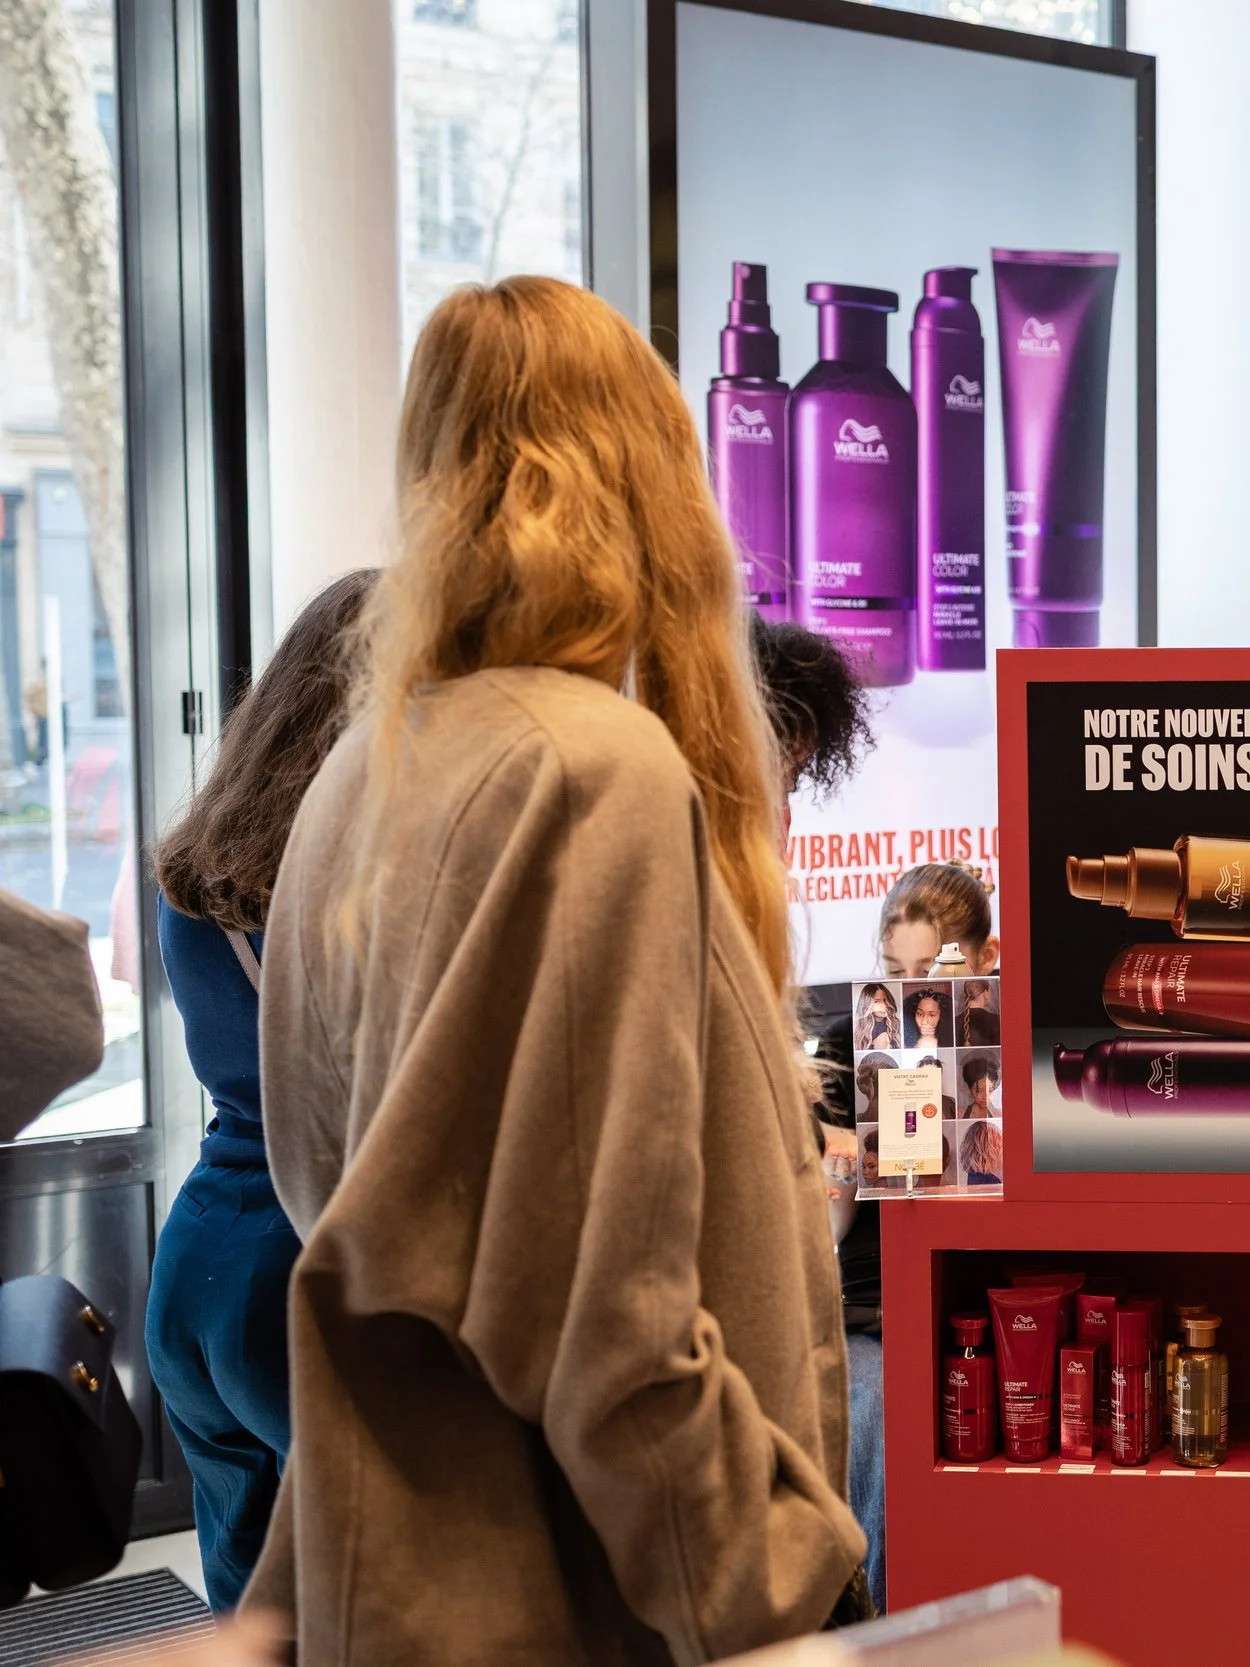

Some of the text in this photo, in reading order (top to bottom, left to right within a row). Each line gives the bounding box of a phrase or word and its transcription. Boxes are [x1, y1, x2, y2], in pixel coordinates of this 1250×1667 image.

[1017, 338, 1061, 352] WELLA
[944, 393, 983, 408] WELLA
[727, 424, 773, 439] WELLA
[834, 440, 889, 458] WELLA
[933, 553, 980, 566] ULTIMATE
[933, 565, 968, 577] COLOR
[1084, 709, 1159, 738] NOTRE
[1085, 744, 1134, 791] DE
[910, 828, 972, 864] PLUS
[1229, 860, 1241, 910] WELLA
[1138, 954, 1150, 978] MIRACLE
[1166, 954, 1183, 988] REPAIR
[1176, 955, 1192, 1003] ULTIMATE
[1119, 989, 1125, 998] OZ
[1164, 1051, 1174, 1100] WELLA
